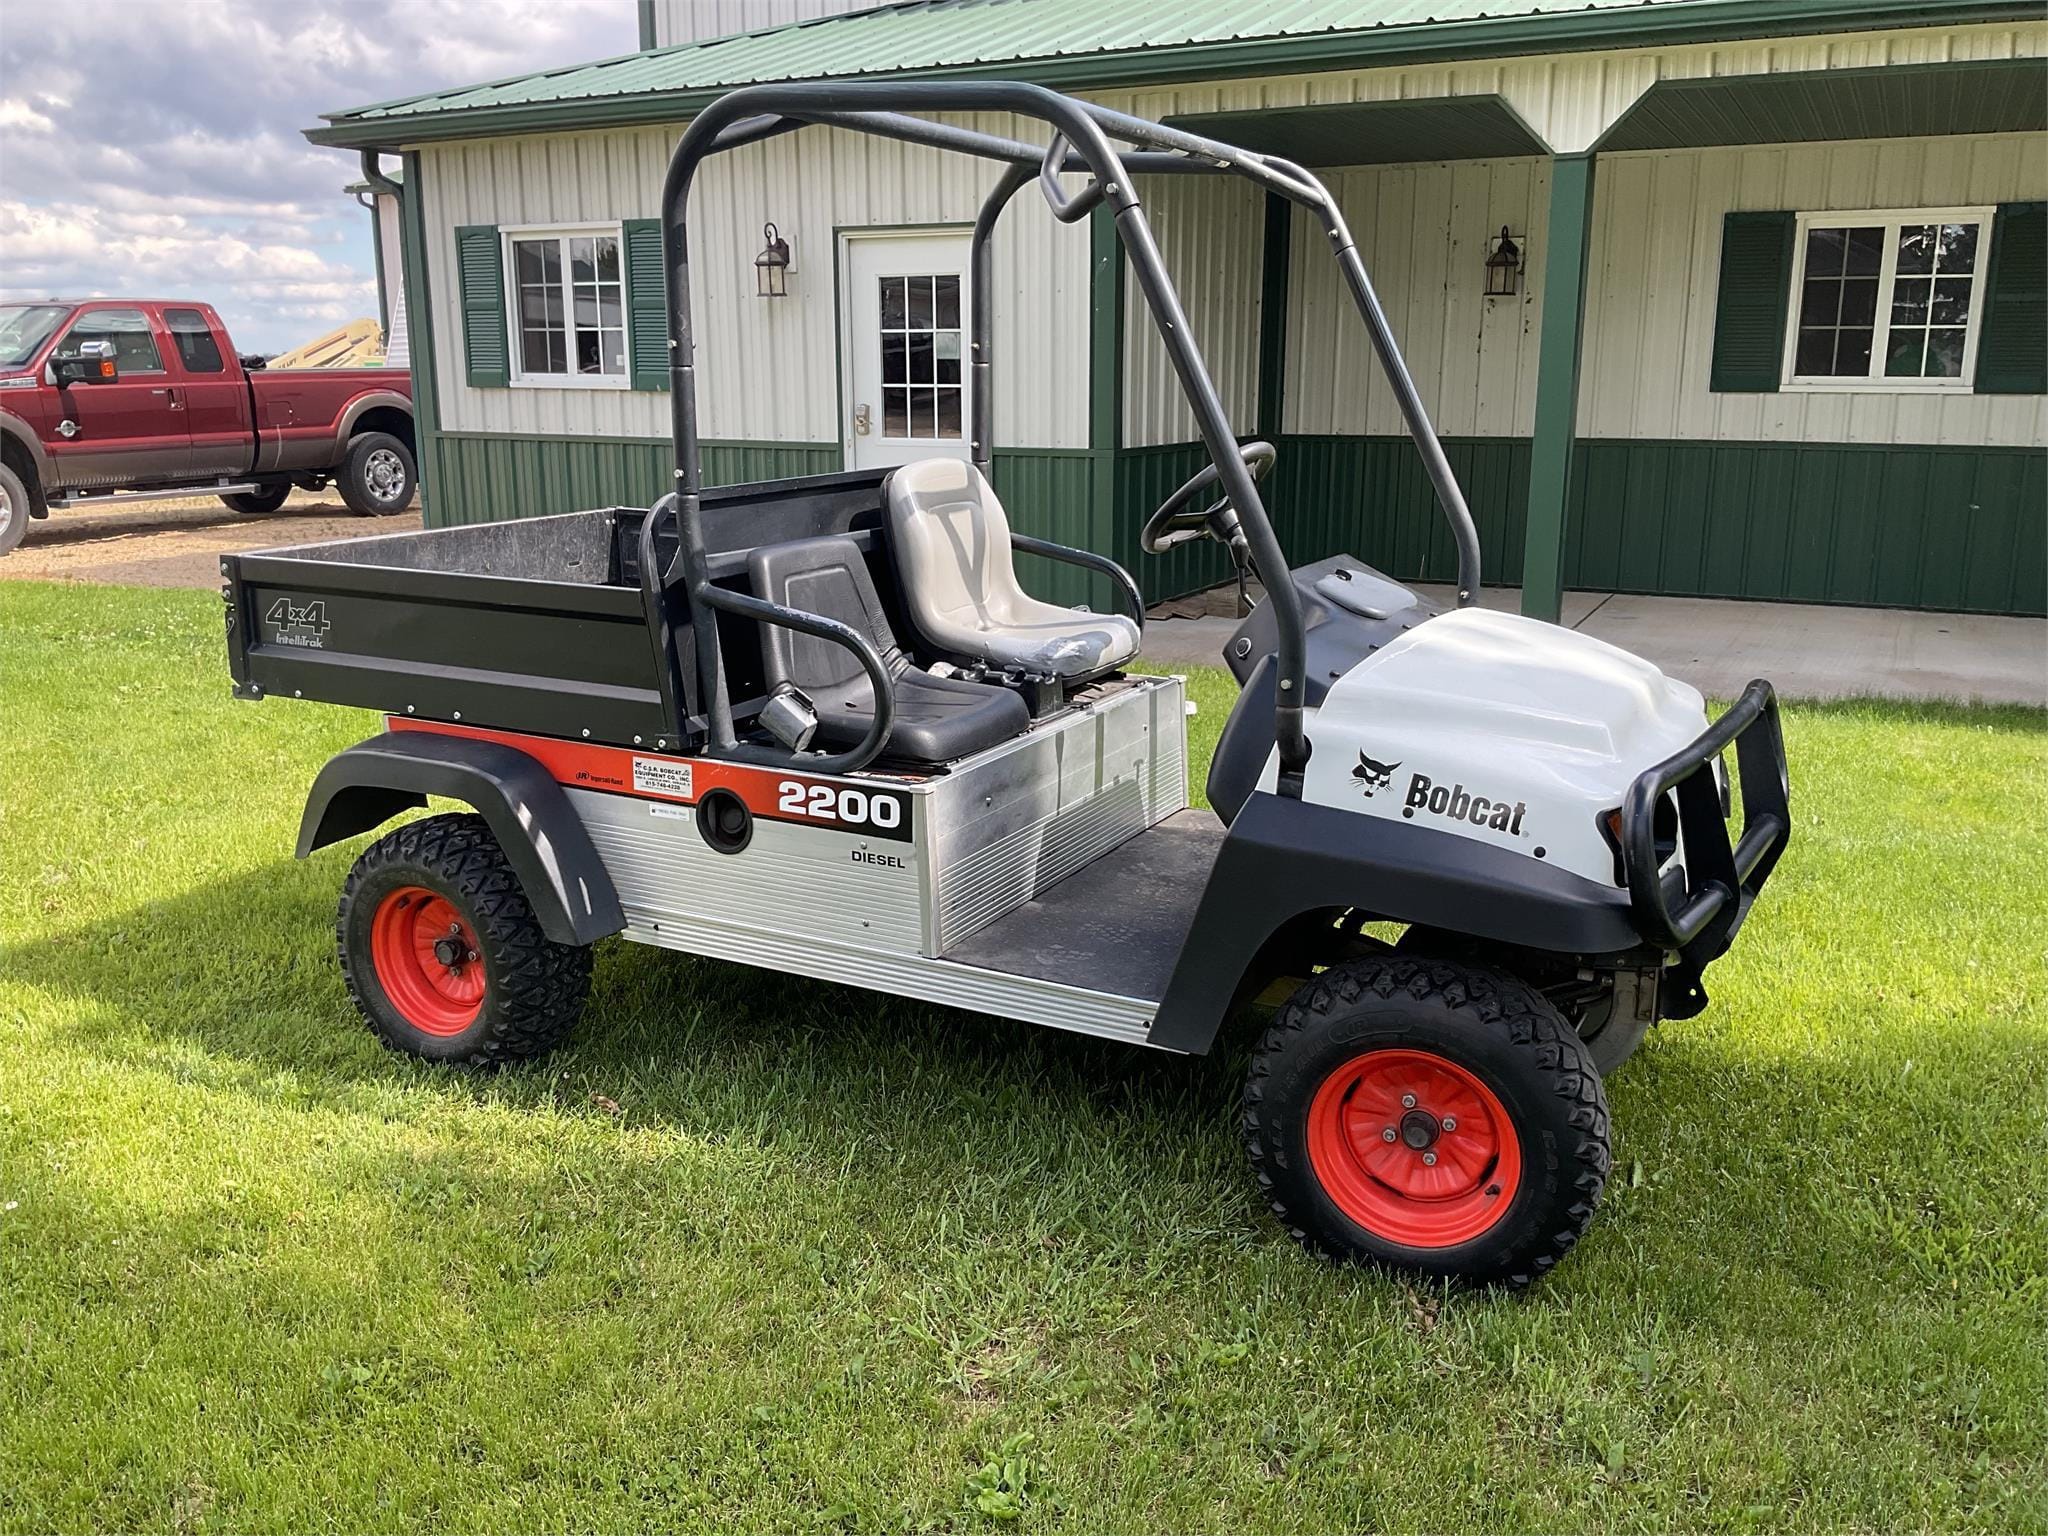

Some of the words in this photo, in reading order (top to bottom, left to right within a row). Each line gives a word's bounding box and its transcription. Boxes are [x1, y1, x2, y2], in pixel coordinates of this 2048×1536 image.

[265, 597, 331, 636] 4x4
[276, 632, 323, 648] IntelliTrak
[635, 769, 666, 778] EQUIPMENT
[778, 781, 901, 829] 2200
[1405, 772, 1526, 837] Bobcat
[851, 851, 906, 869] DIESEL
